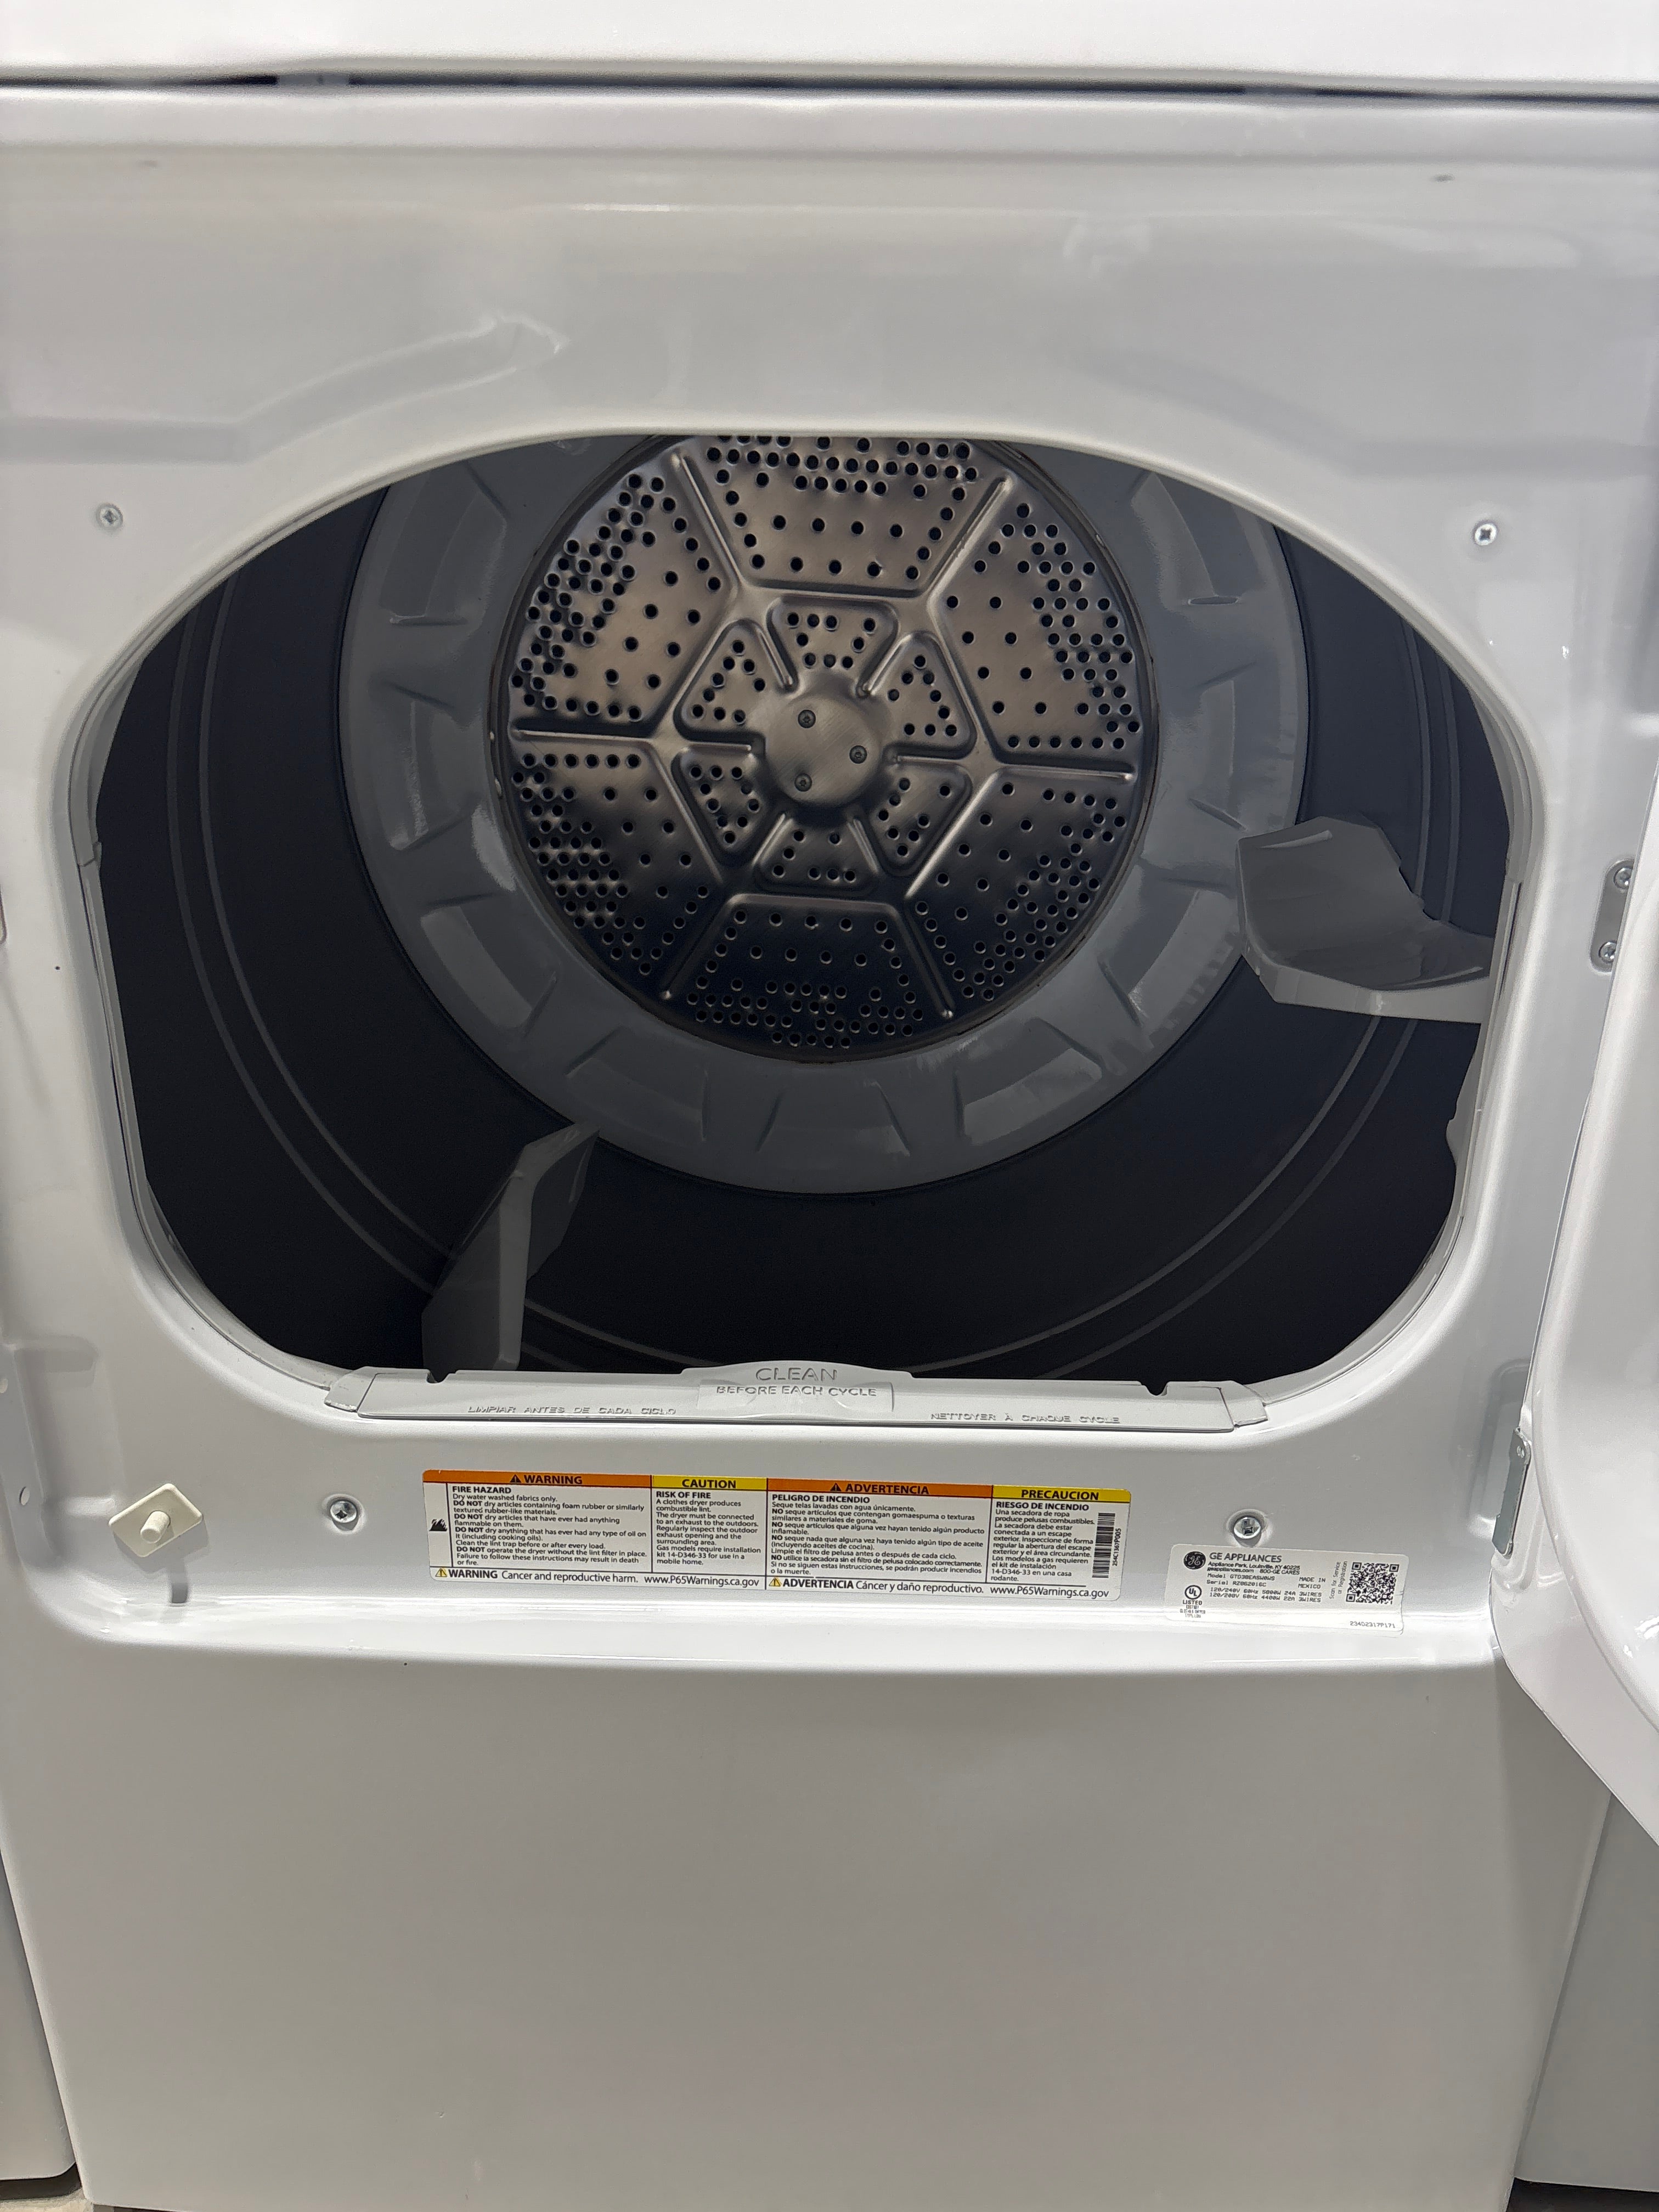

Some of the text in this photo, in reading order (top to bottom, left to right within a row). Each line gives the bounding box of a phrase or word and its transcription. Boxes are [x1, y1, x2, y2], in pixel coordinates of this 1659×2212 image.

[755, 1368, 837, 1381] CLEAN
[716, 1386, 877, 1396] BEFORE EACH CYCLE
[931, 1413, 996, 1421] NETTOYER
[1005, 1413, 1013, 1421] À
[524, 1475, 583, 1485] WARNING
[681, 1479, 736, 1488] CAUTION
[845, 1483, 929, 1494] ADVERTENCIA
[826, 1495, 870, 1503] INCENDIO
[1021, 1489, 1099, 1500] PRECAUCION
[523, 1502, 561, 1510] containing
[689, 1499, 708, 1507] dryer
[709, 1499, 742, 1508] produces
[772, 1501, 794, 1509] Seque
[1045, 1503, 1090, 1511] INCENDIO
[670, 1511, 688, 1520] dryer
[853, 1510, 890, 1519] contengan
[995, 1515, 1023, 1523] produce
[1023, 1516, 1048, 1524] pelusas
[1333, 1561, 1341, 1578] Service
[1338, 1561, 1347, 1588] Registration
[448, 1569, 639, 1584] WARNING Cancer and reproductive harm.
[644, 1576, 760, 1587] www.P65Warnings.ca.gov
[783, 1578, 984, 1595] ADVERTENCIA Cáncer y daño reproductivo.
[990, 1586, 1109, 1599] www.P65Warnings.ca.gov
